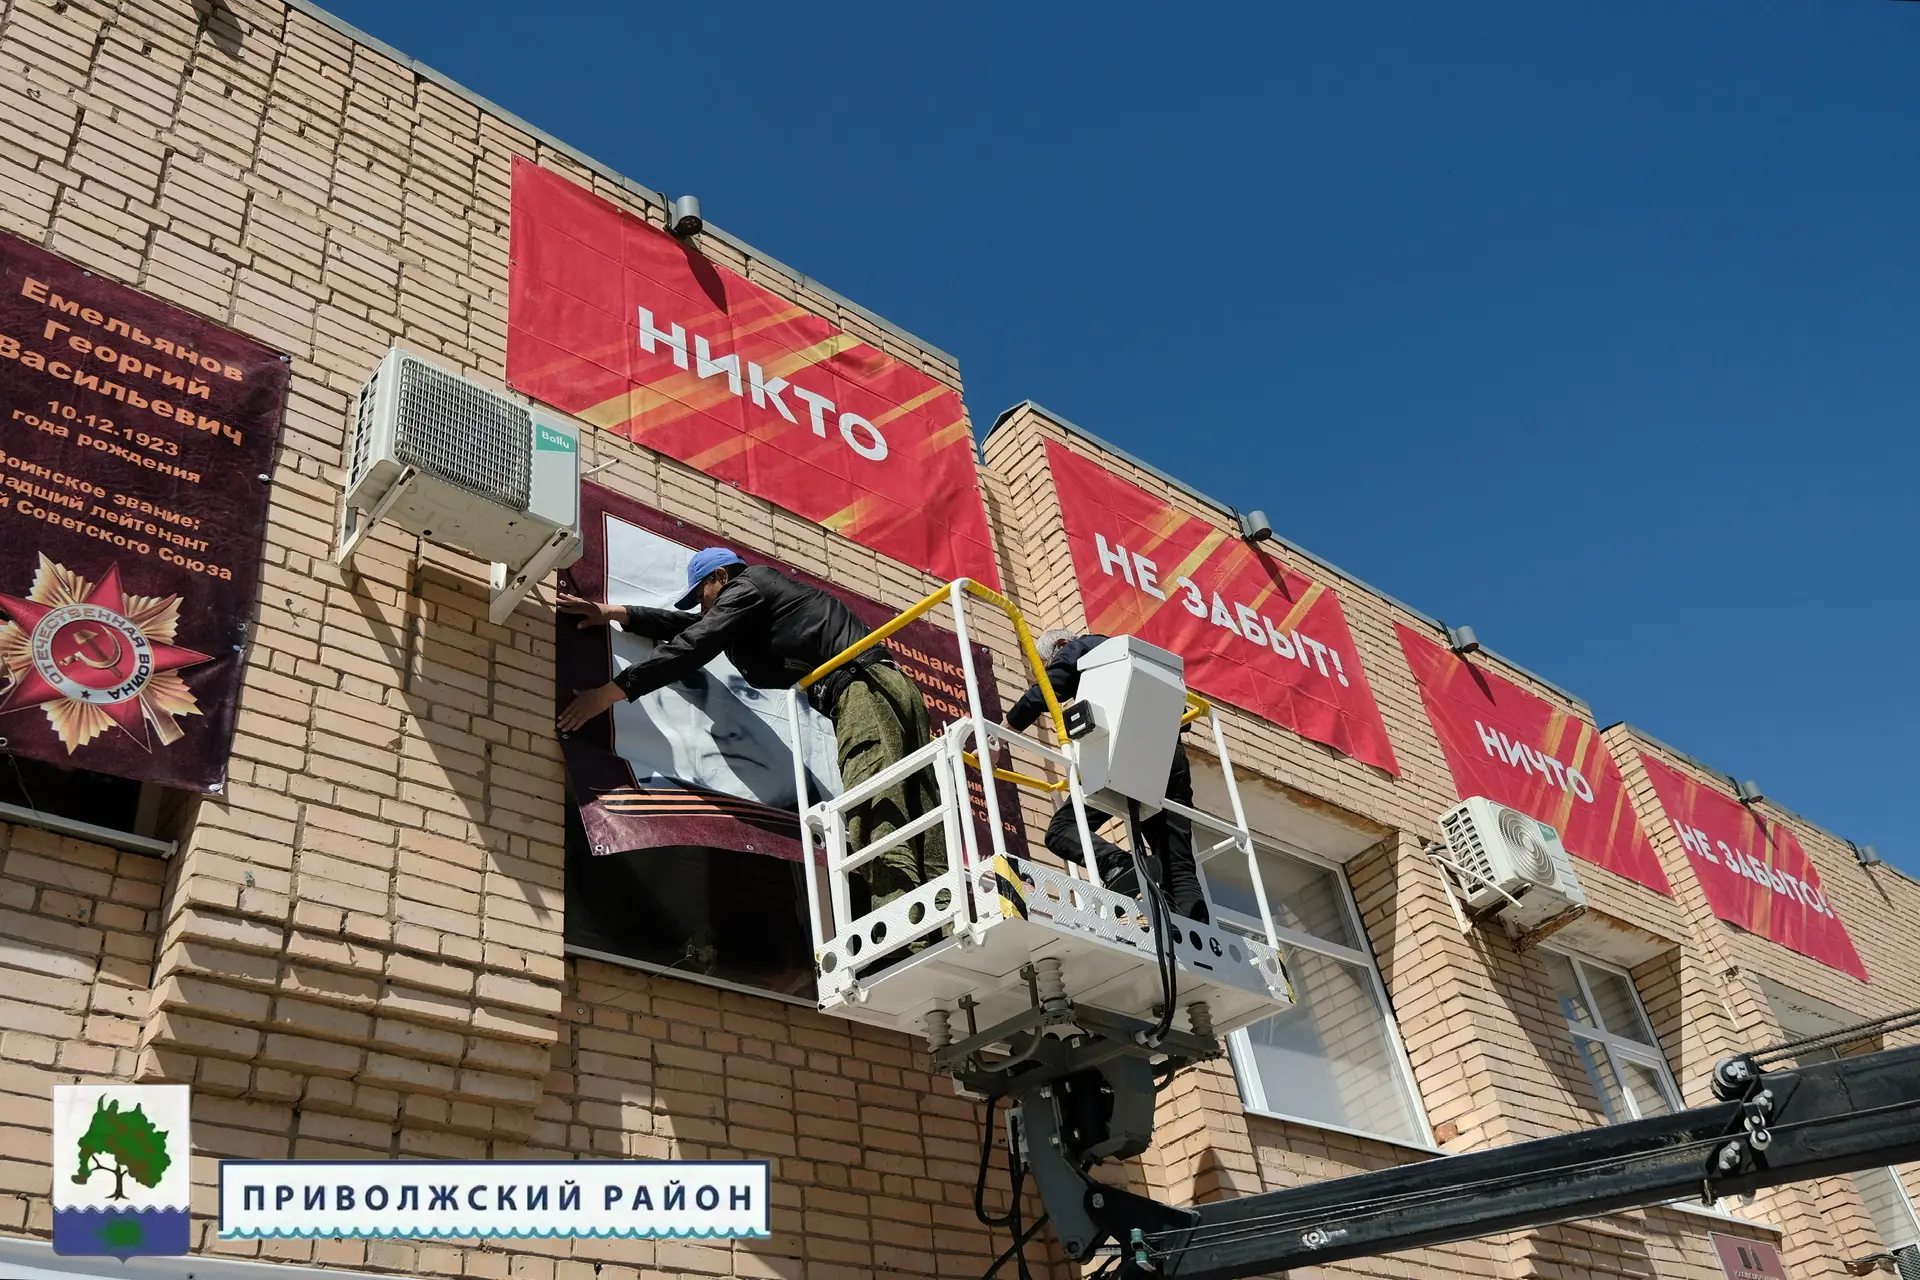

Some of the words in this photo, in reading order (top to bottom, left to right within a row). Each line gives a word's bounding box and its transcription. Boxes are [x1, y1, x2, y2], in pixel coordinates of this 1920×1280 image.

[22, 277, 243, 382] Емельянов
[44, 319, 211, 400] Георгий
[0, 333, 242, 446] Васильевич
[638, 305, 889, 461] НИКТО
[12, 410, 69, 438] года
[77, 433, 200, 483] рождения
[48, 400, 178, 456] 10.12.1923
[541, 431, 570, 449] Ballu
[17, 500, 150, 555] Советского
[158, 548, 232, 580] Союза
[90, 505, 208, 552] лейтенант
[113, 494, 200, 531] звание:
[37, 607, 145, 685] ОТЕЧЕСТВЕННАЯ
[1094, 532, 1166, 601] НЕ
[1176, 576, 1349, 687] ЗАБЫТ!
[900, 664, 967, 702] силий
[1474, 720, 1594, 803] НИЧТО
[1673, 818, 1719, 864] НЕ
[1717, 840, 1834, 918] ЗАБЫТО!
